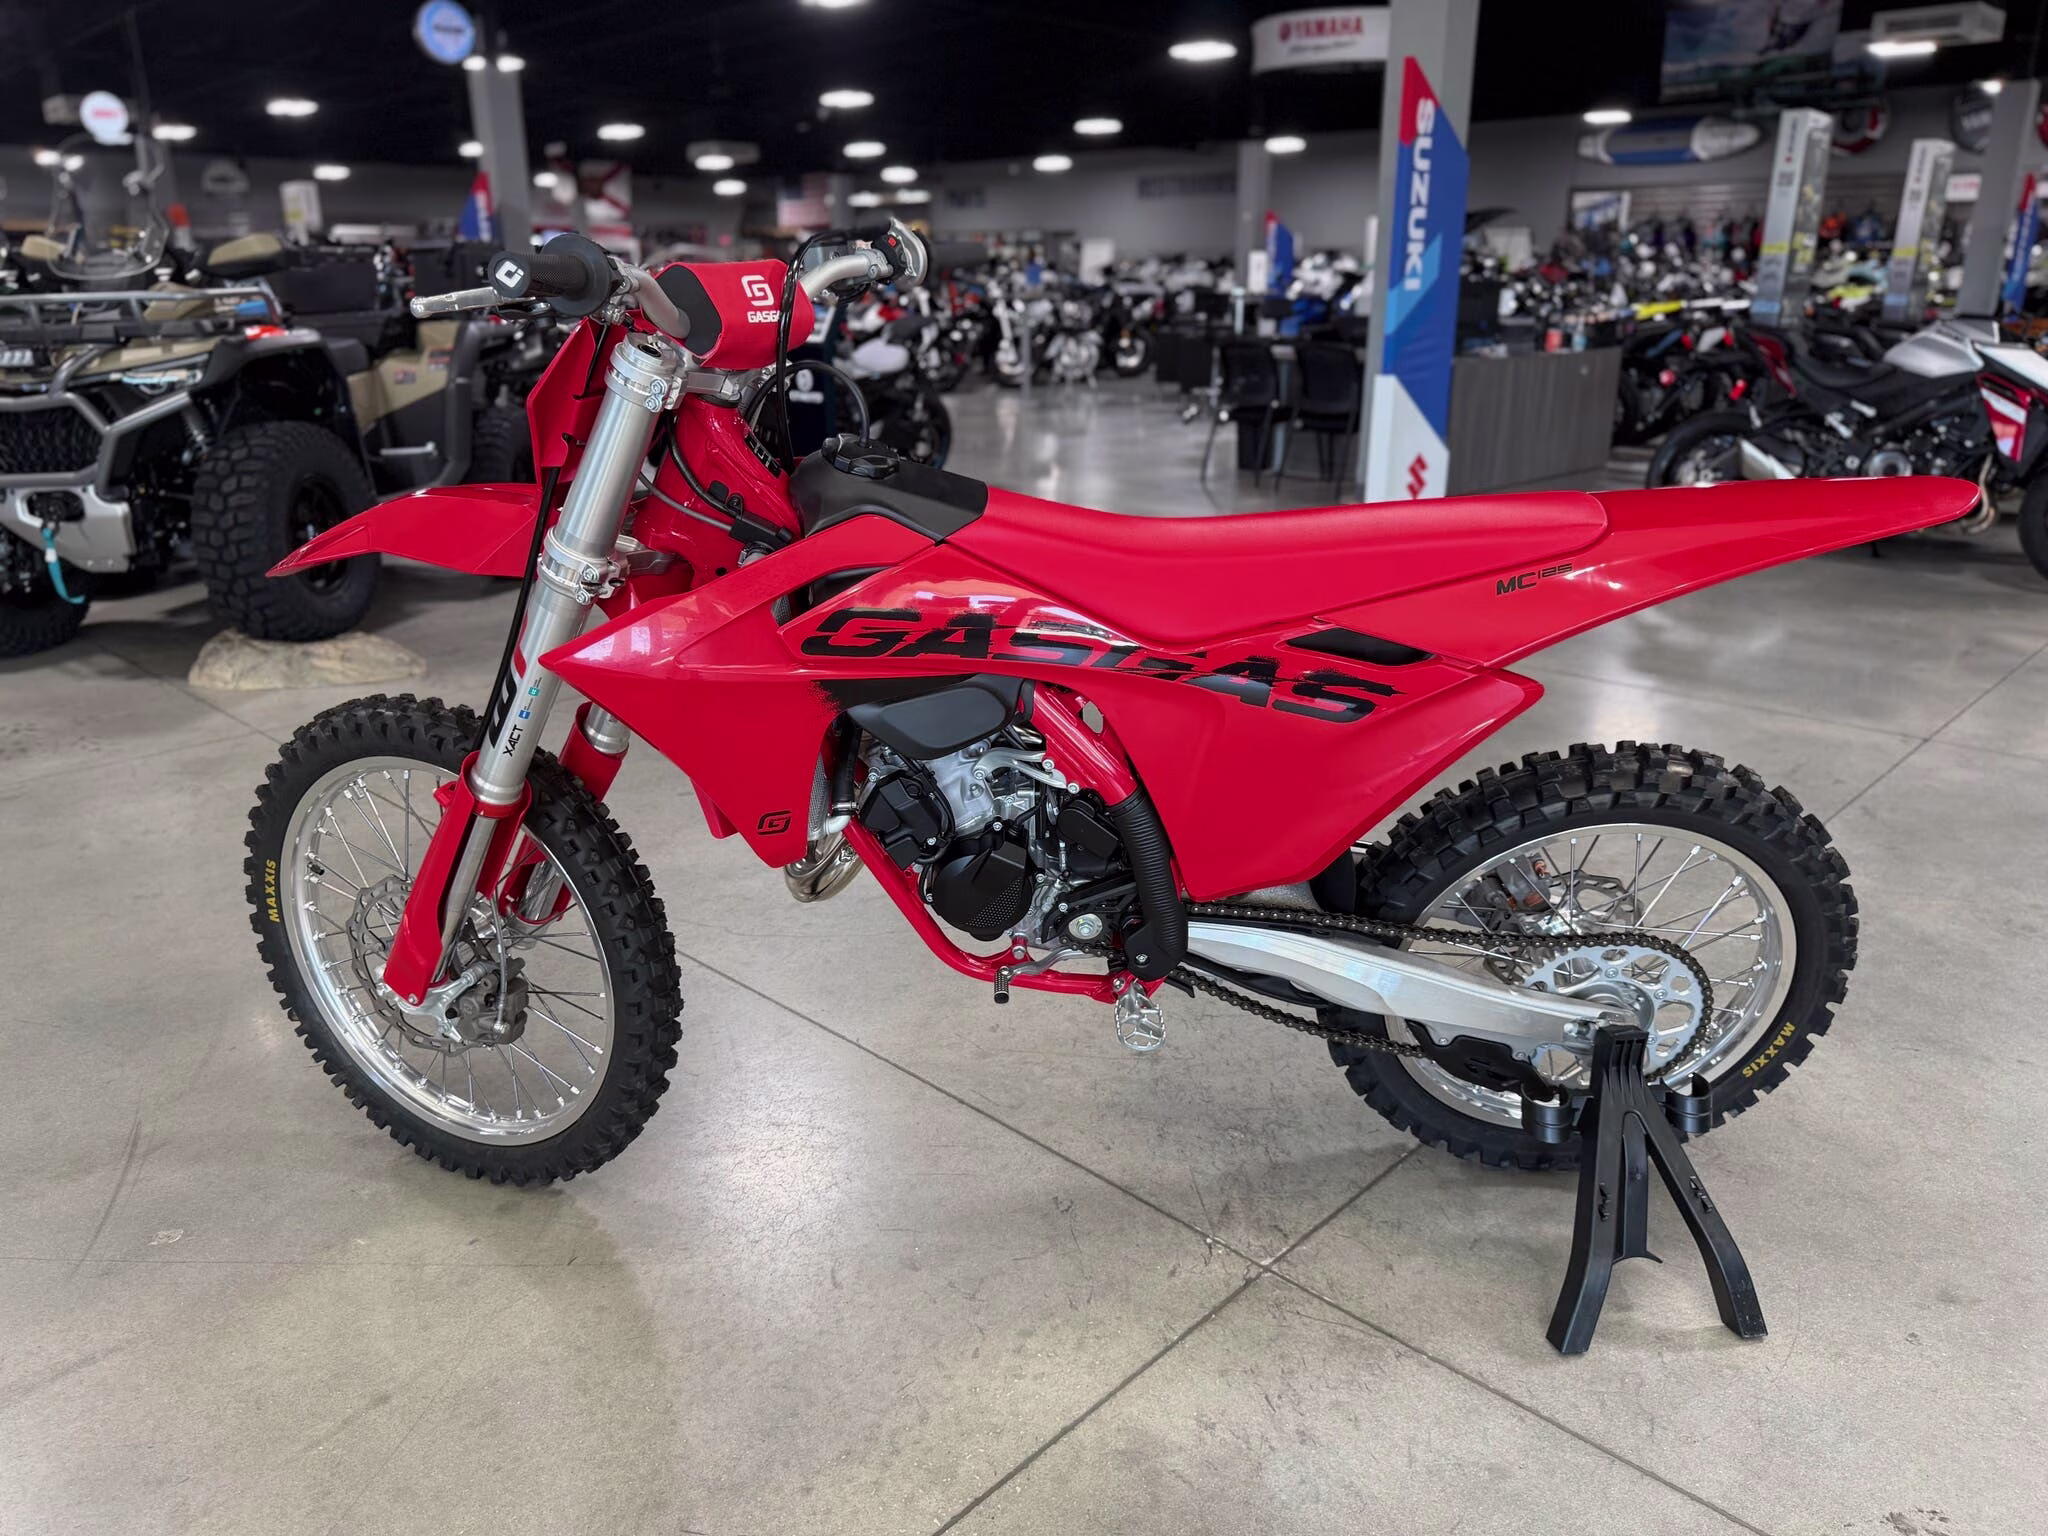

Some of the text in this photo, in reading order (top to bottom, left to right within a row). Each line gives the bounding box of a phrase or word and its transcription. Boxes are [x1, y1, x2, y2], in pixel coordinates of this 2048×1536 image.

[1404, 98, 1435, 291] SUZUKI
[747, 310, 780, 323] GASG
[1496, 571, 1537, 595] MC
[503, 724, 524, 757] XACT
[264, 859, 281, 923] MAXXIS
[1742, 1021, 1797, 1078] MAXXIS
